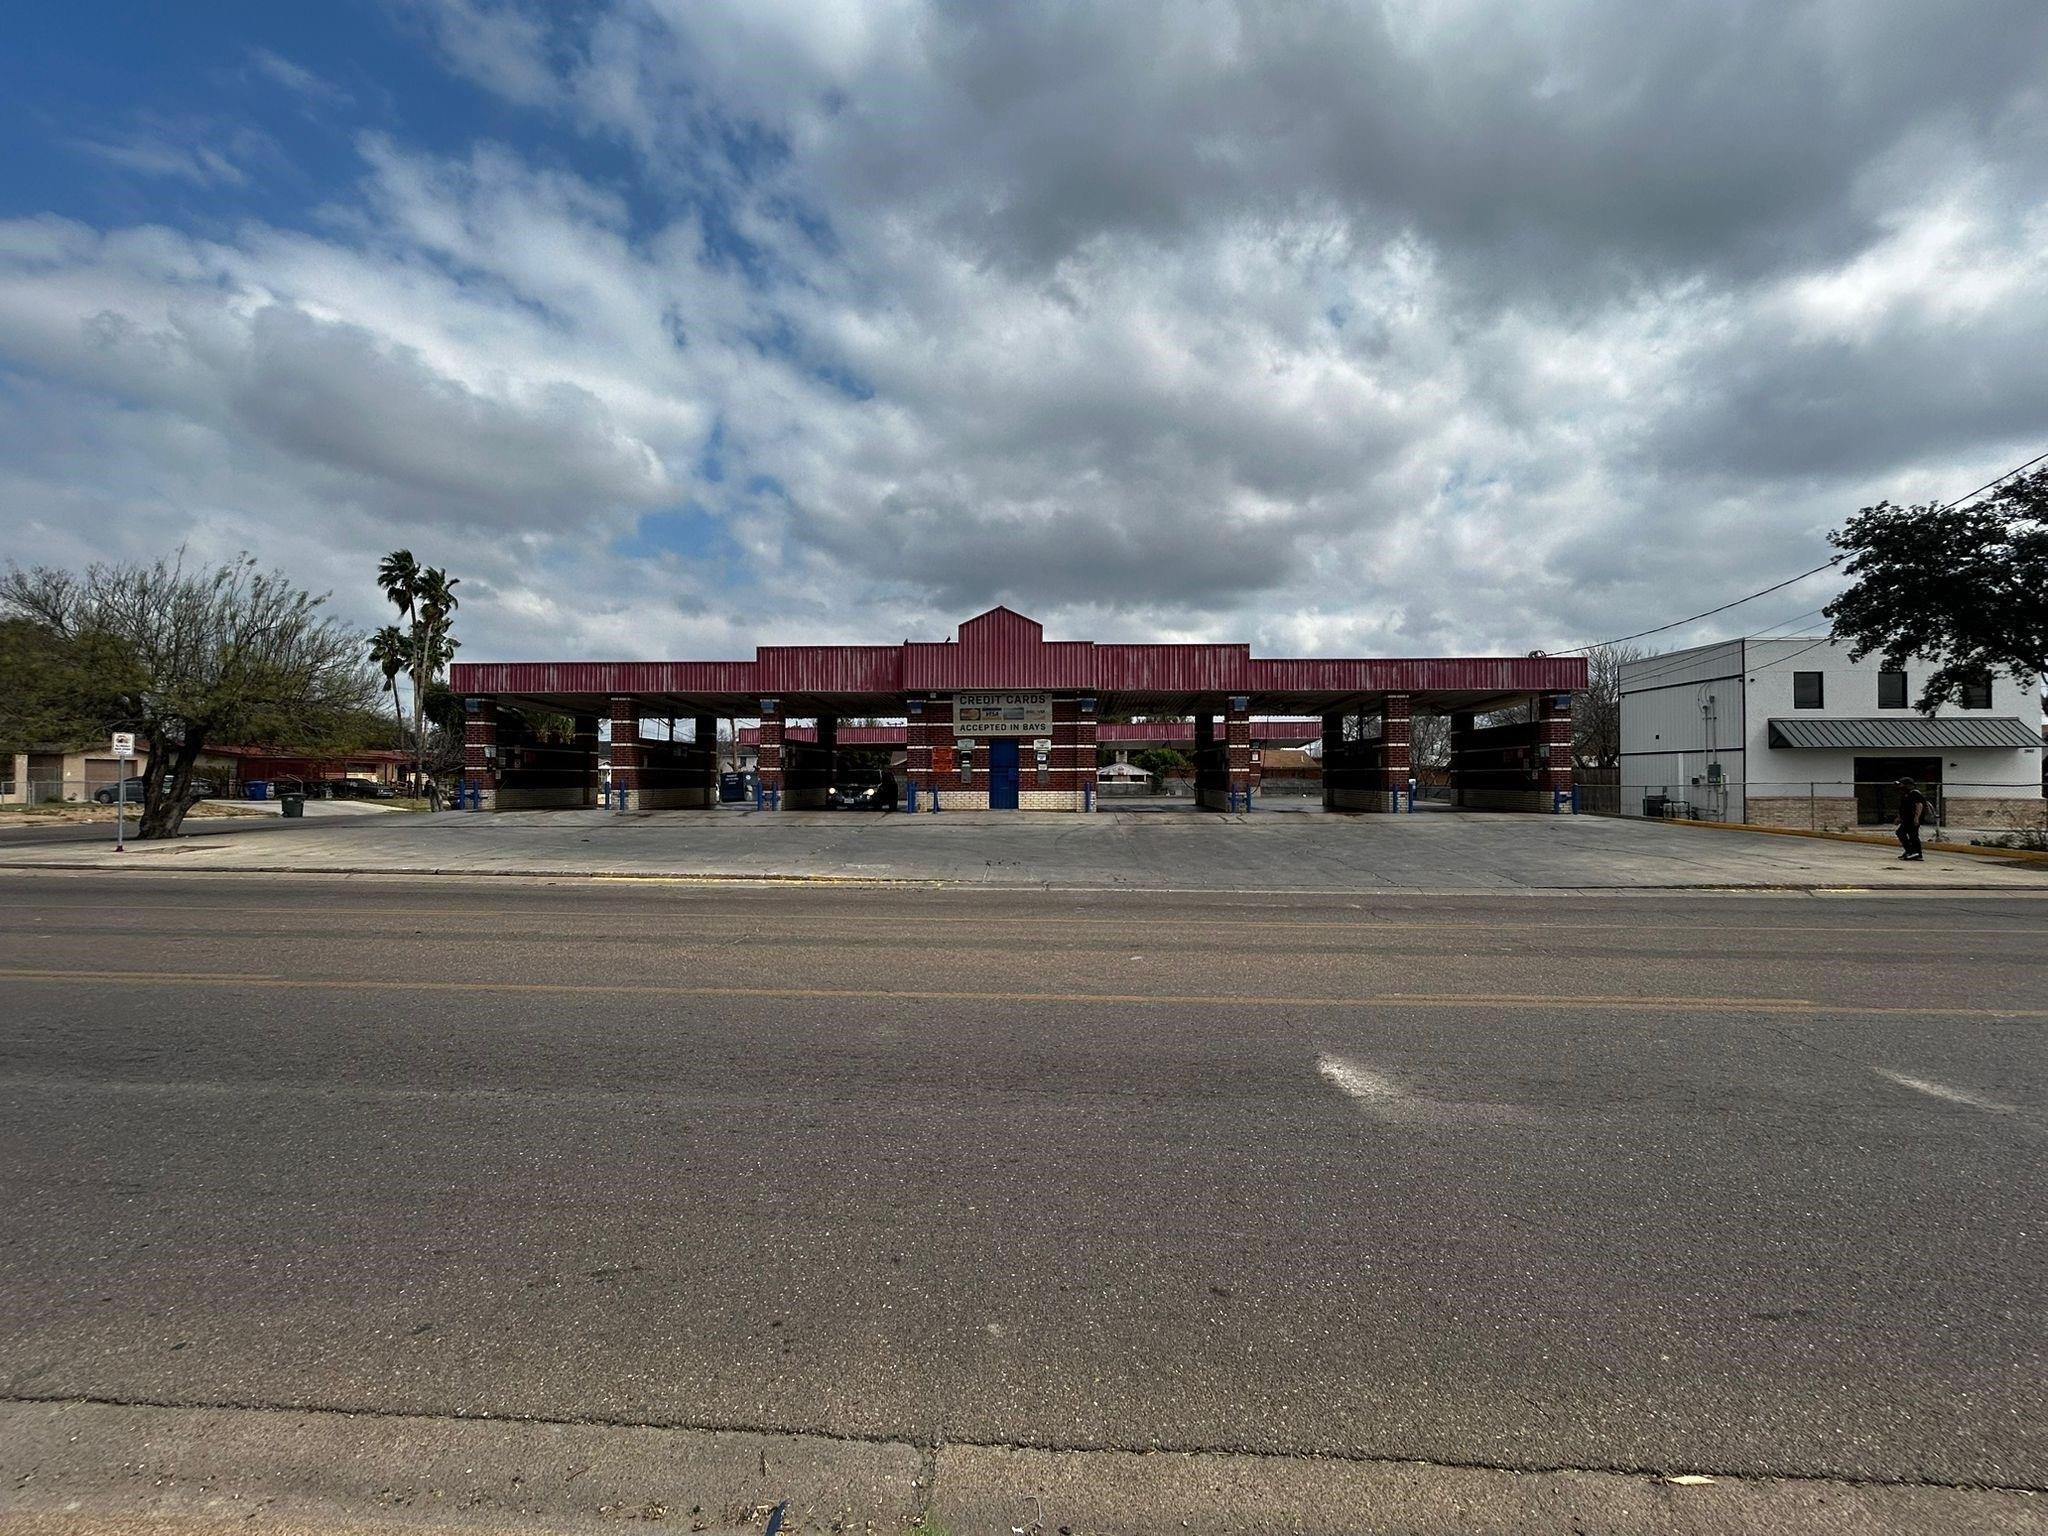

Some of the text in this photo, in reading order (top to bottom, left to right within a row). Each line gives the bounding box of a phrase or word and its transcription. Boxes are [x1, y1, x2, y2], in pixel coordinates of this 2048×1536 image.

[960, 695, 1045, 704] CREDIT CARDS
[960, 724, 1006, 732] ACCEPTED
[1023, 723, 1046, 731] BAYS
